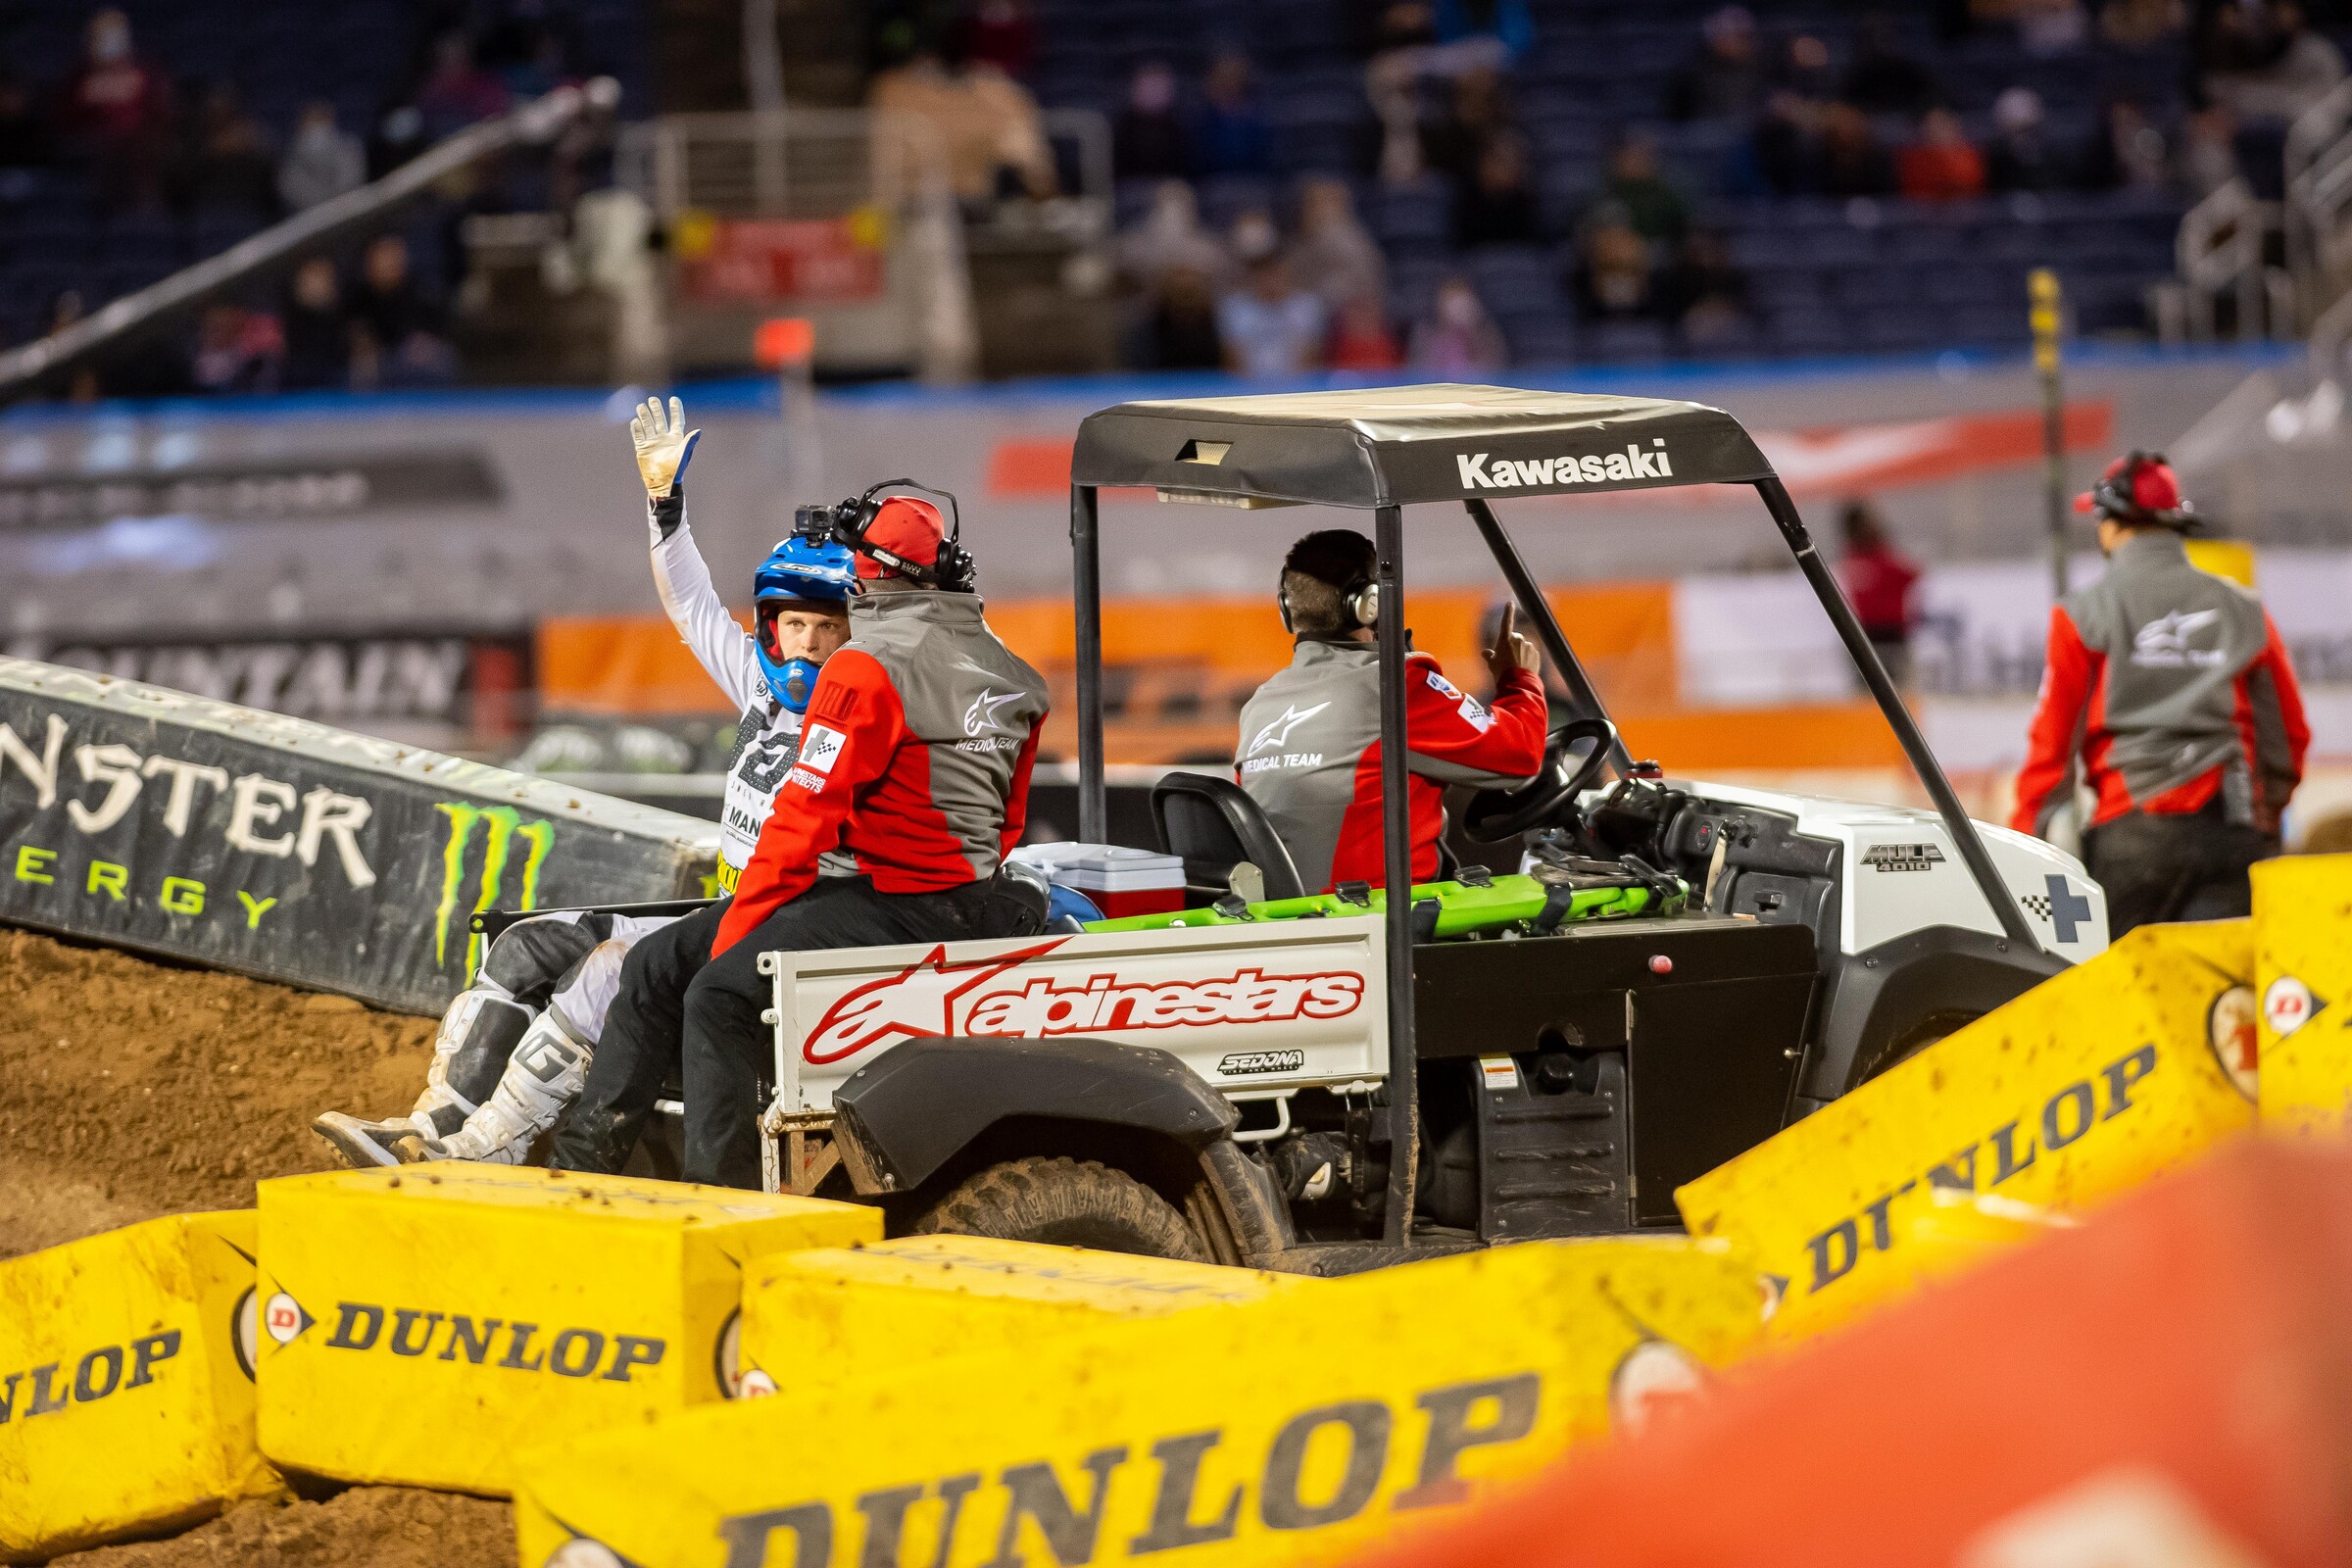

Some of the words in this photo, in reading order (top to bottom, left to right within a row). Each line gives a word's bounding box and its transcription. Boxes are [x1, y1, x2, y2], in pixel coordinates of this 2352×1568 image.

[1456, 438, 1673, 489] Kawasaki
[1243, 756, 1280, 774] MEDICAL
[1283, 753, 1323, 767] TEAM
[0, 712, 376, 888] NSTER
[1860, 843, 1946, 864] MULE
[1878, 862, 1931, 871] 4010
[15, 845, 276, 930] ERGY
[964, 967, 1365, 1038] alpinestars
[1219, 1051, 1302, 1070] SEDONA
[272, 1308, 296, 1328] D
[326, 1301, 666, 1383] DUNLOP
[718, 1372, 1541, 1568] DUNLOP
